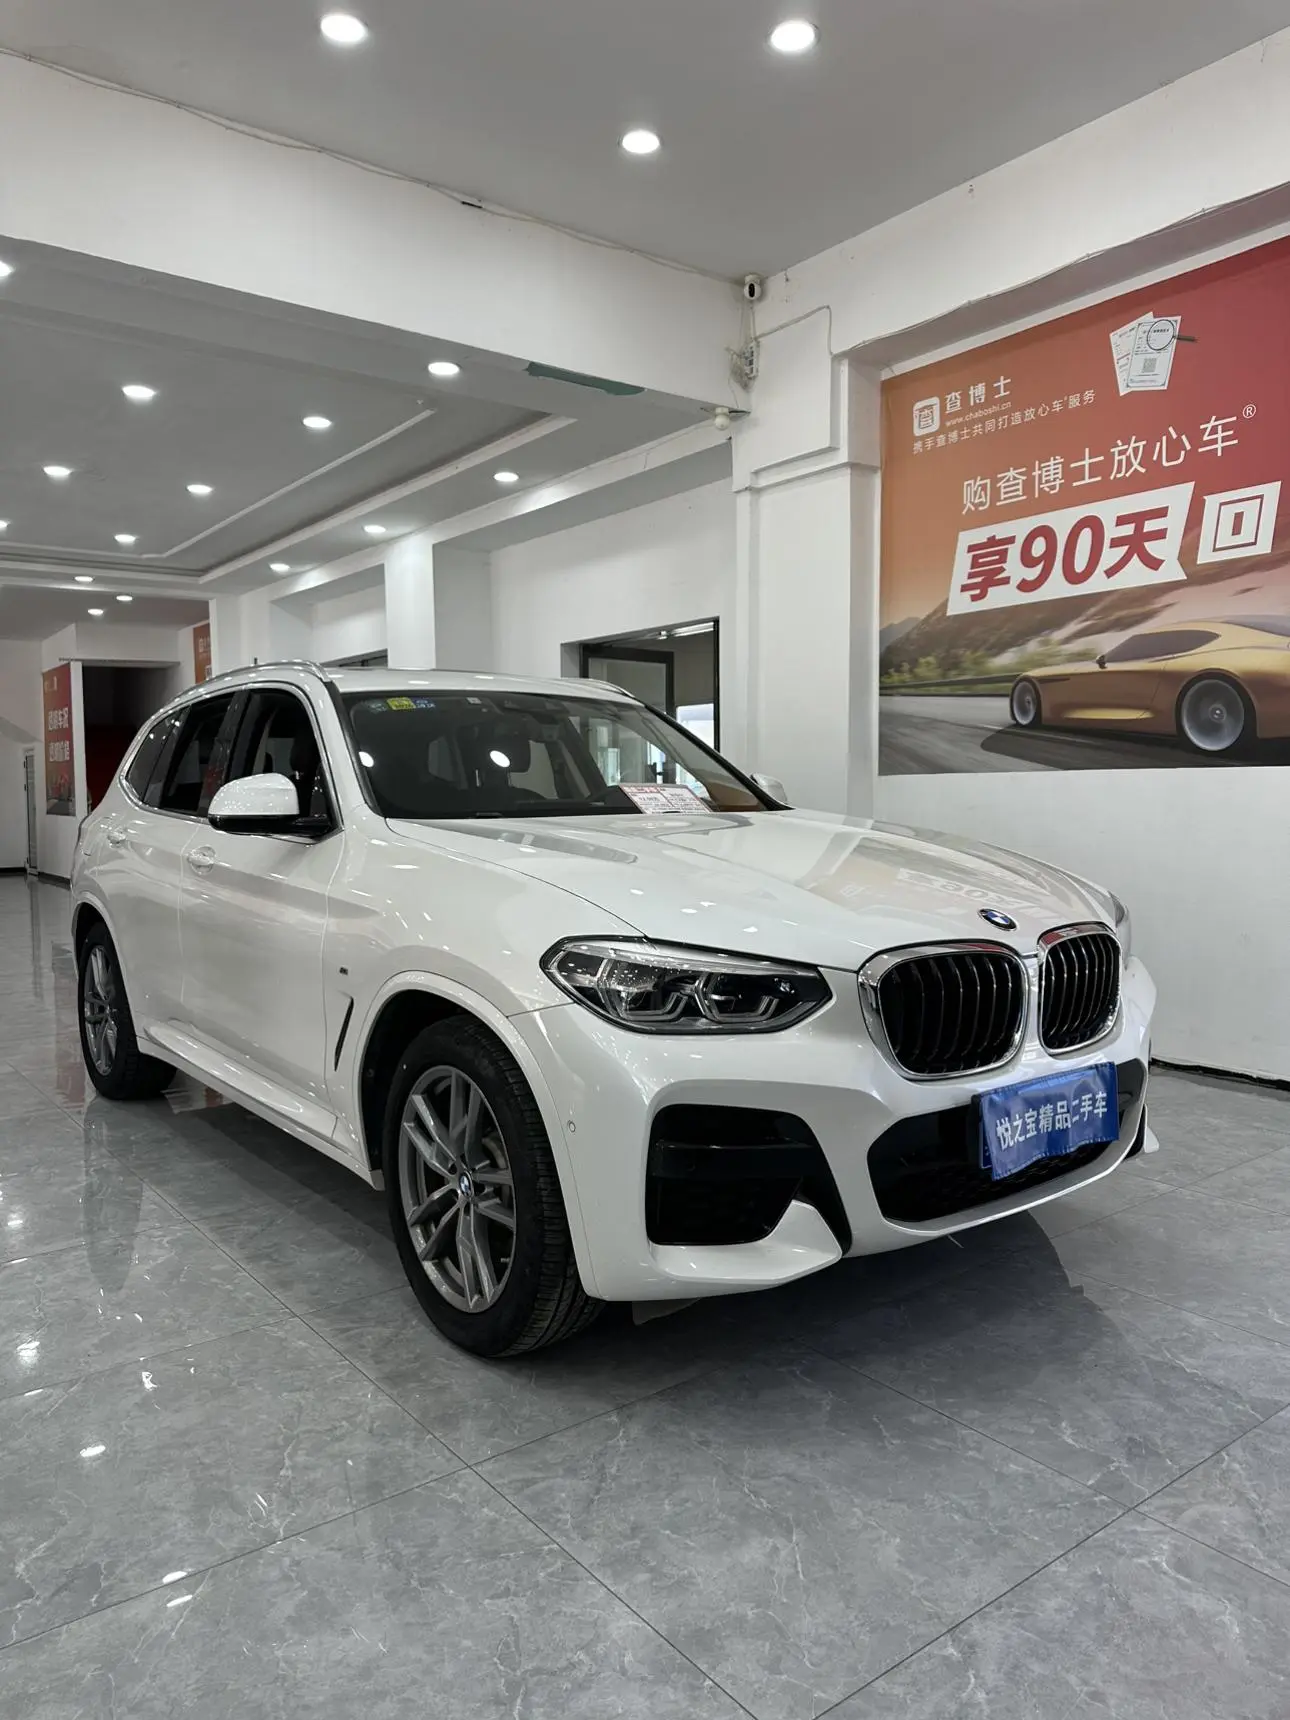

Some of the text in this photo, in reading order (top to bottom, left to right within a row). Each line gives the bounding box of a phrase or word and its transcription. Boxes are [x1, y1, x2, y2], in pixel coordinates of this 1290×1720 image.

[945, 375, 1011, 414] 查博士
[960, 505, 1170, 602] 享90天
[996, 1090, 1108, 1151] 悦之宝精品二手车
